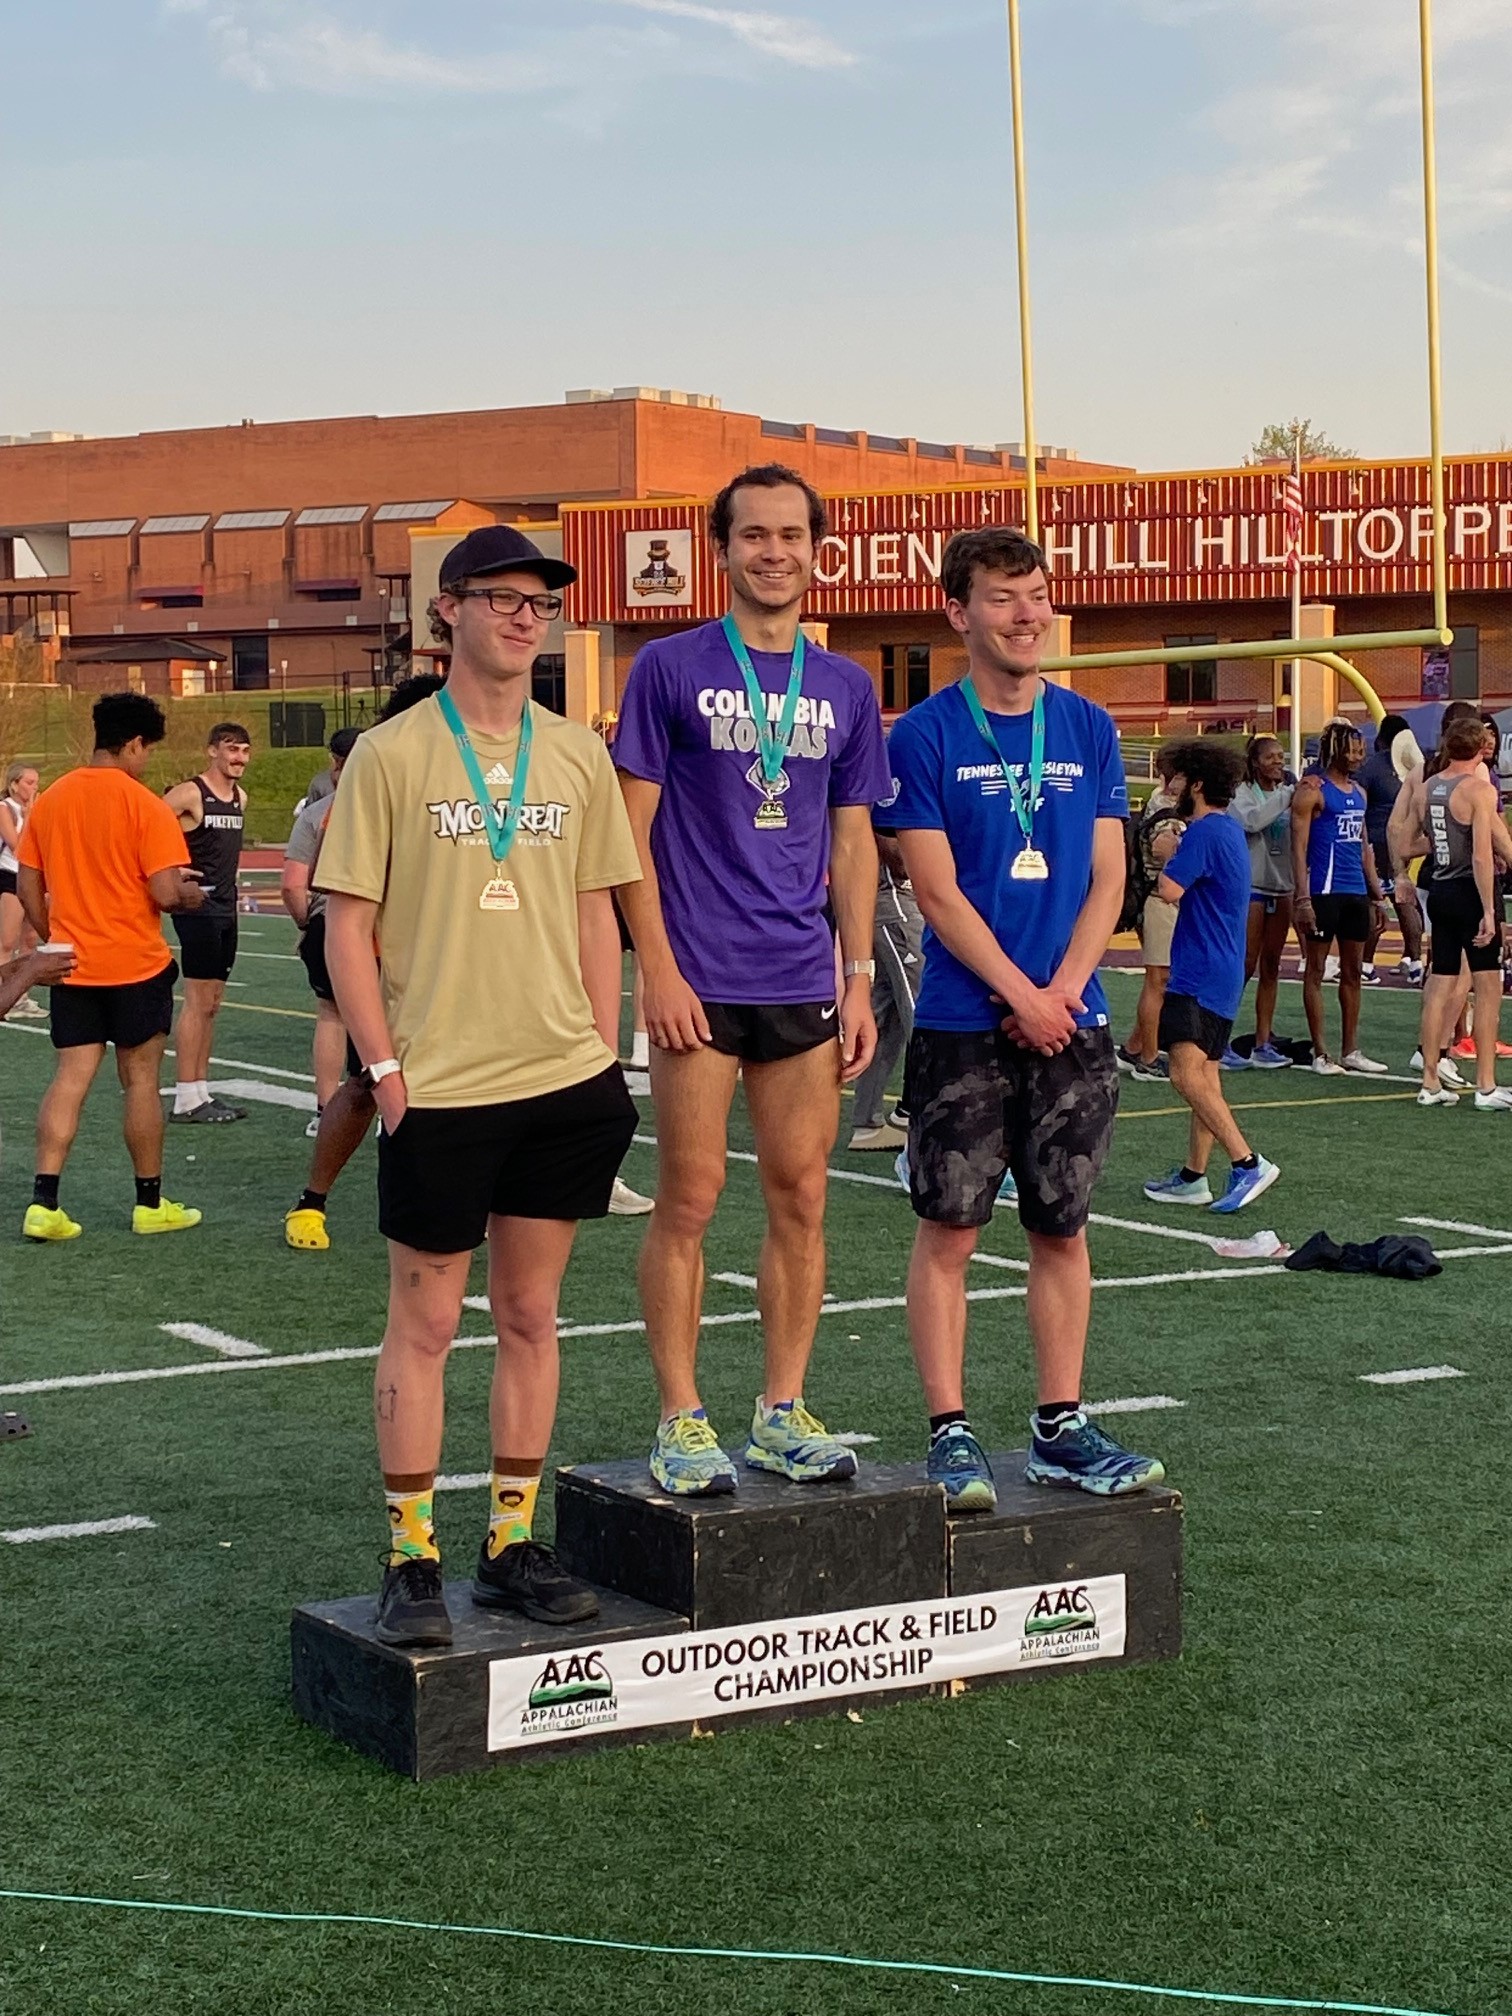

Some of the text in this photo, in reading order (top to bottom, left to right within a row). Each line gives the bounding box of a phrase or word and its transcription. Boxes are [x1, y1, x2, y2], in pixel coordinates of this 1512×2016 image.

[813, 532, 942, 582] CIEN
[1045, 521, 1168, 573] HILL
[957, 761, 1084, 782] TENNESEE ESLEYAN
[426, 798, 571, 846] MONREAT
[1430, 804, 1450, 866] BEARS
[1034, 1585, 1088, 1618] AAC
[641, 1605, 998, 1677] OUTDOOR TRACK & FIELD
[1020, 1629, 1100, 1651] APPALACHIAN
[540, 1650, 604, 1689] AAC
[713, 1647, 933, 1701] CHAMPIONSHIP
[521, 1698, 618, 1725] APPALACHIAN
[521, 1712, 618, 1733] Athletic Conference
